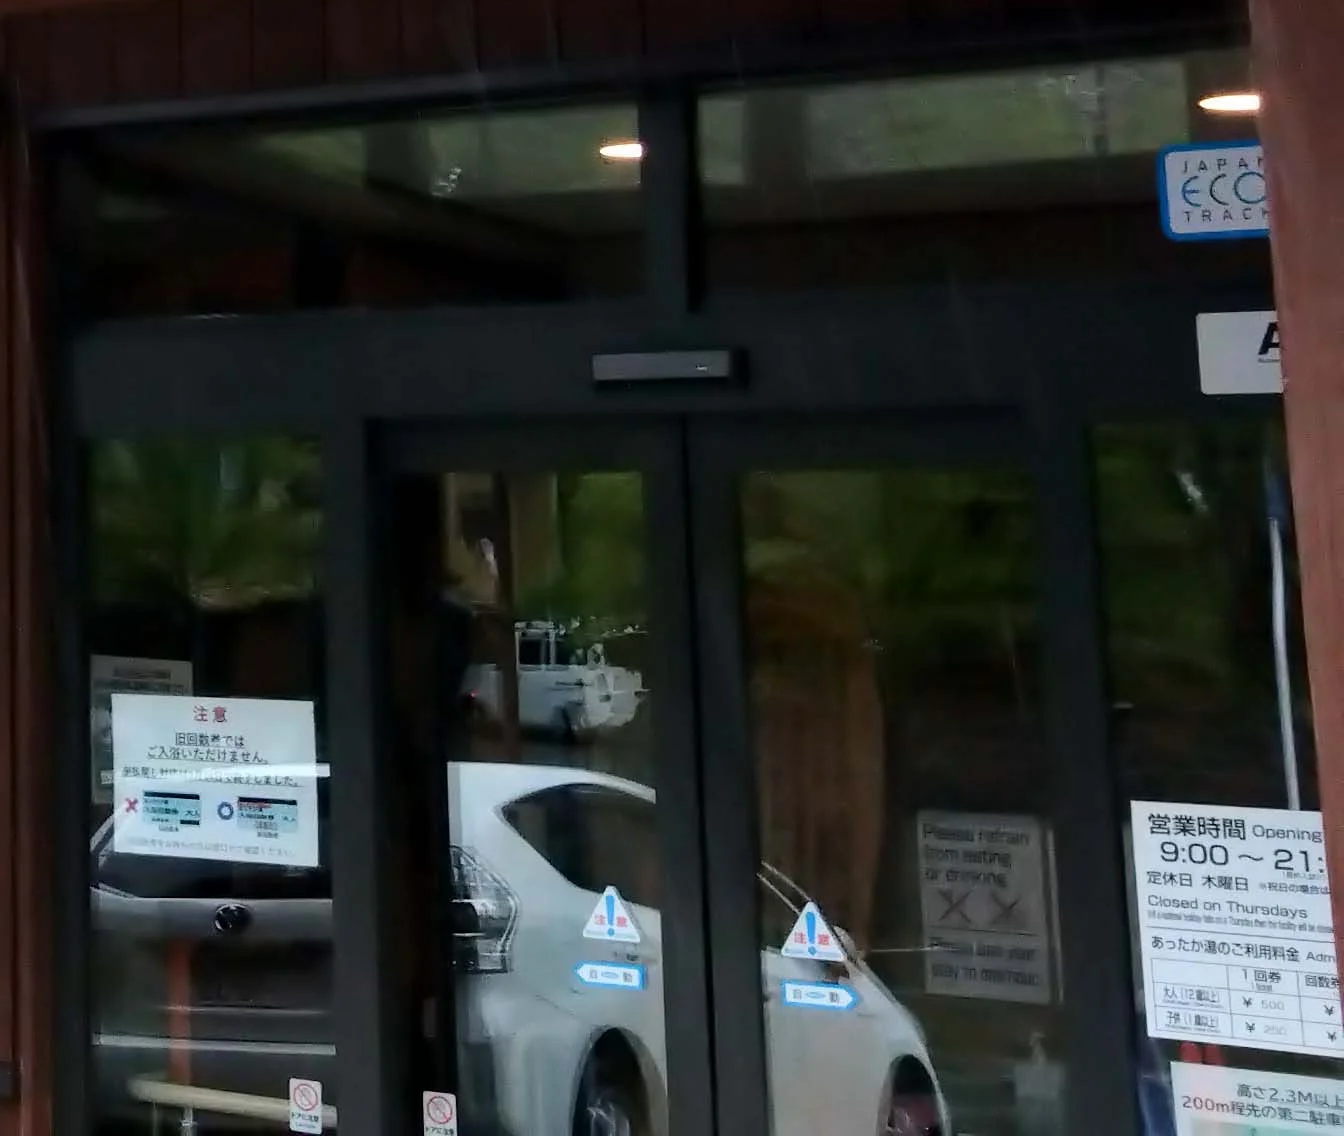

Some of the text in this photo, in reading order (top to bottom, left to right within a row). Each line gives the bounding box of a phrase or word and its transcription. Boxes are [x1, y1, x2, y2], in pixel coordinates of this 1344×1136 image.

[1181, 171, 1267, 207] ECO
[193, 705, 227, 723] 注意
[147, 746, 268, 765] ご入浴いただけません。
[1148, 813, 1322, 844] 営業時間 Opening
[1160, 842, 1229, 866] 9:00
[1146, 871, 1193, 888] 定休日
[1201, 874, 1249, 892] 木曜日
[1148, 895, 1201, 911] Closed
[1204, 901, 1222, 912] on
[1227, 900, 1308, 919] Thursdays
[1151, 935, 1300, 963] あったか湯のご利用料金
